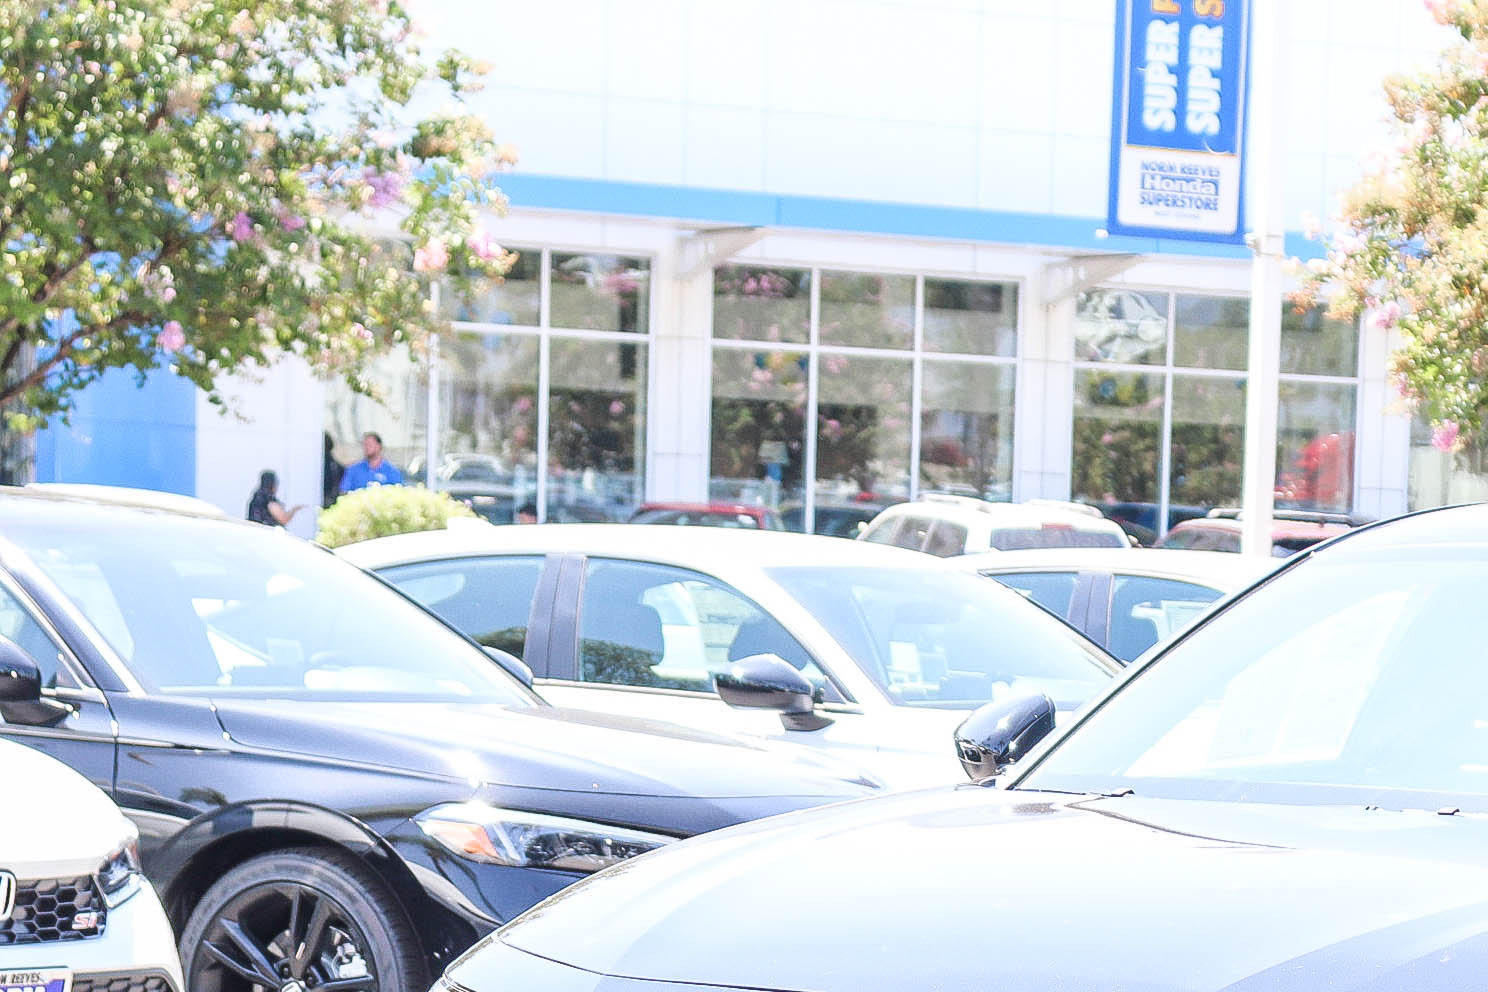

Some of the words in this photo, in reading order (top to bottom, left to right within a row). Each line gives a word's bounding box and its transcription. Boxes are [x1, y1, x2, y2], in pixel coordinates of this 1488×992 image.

[1143, 19, 1180, 132] SUPER
[1186, 22, 1223, 135] SUPER
[1141, 160, 1177, 173] NORM
[1180, 164, 1220, 178] REEVES
[1143, 172, 1217, 195] Honda
[1140, 191, 1219, 212] SUPERSTORE
